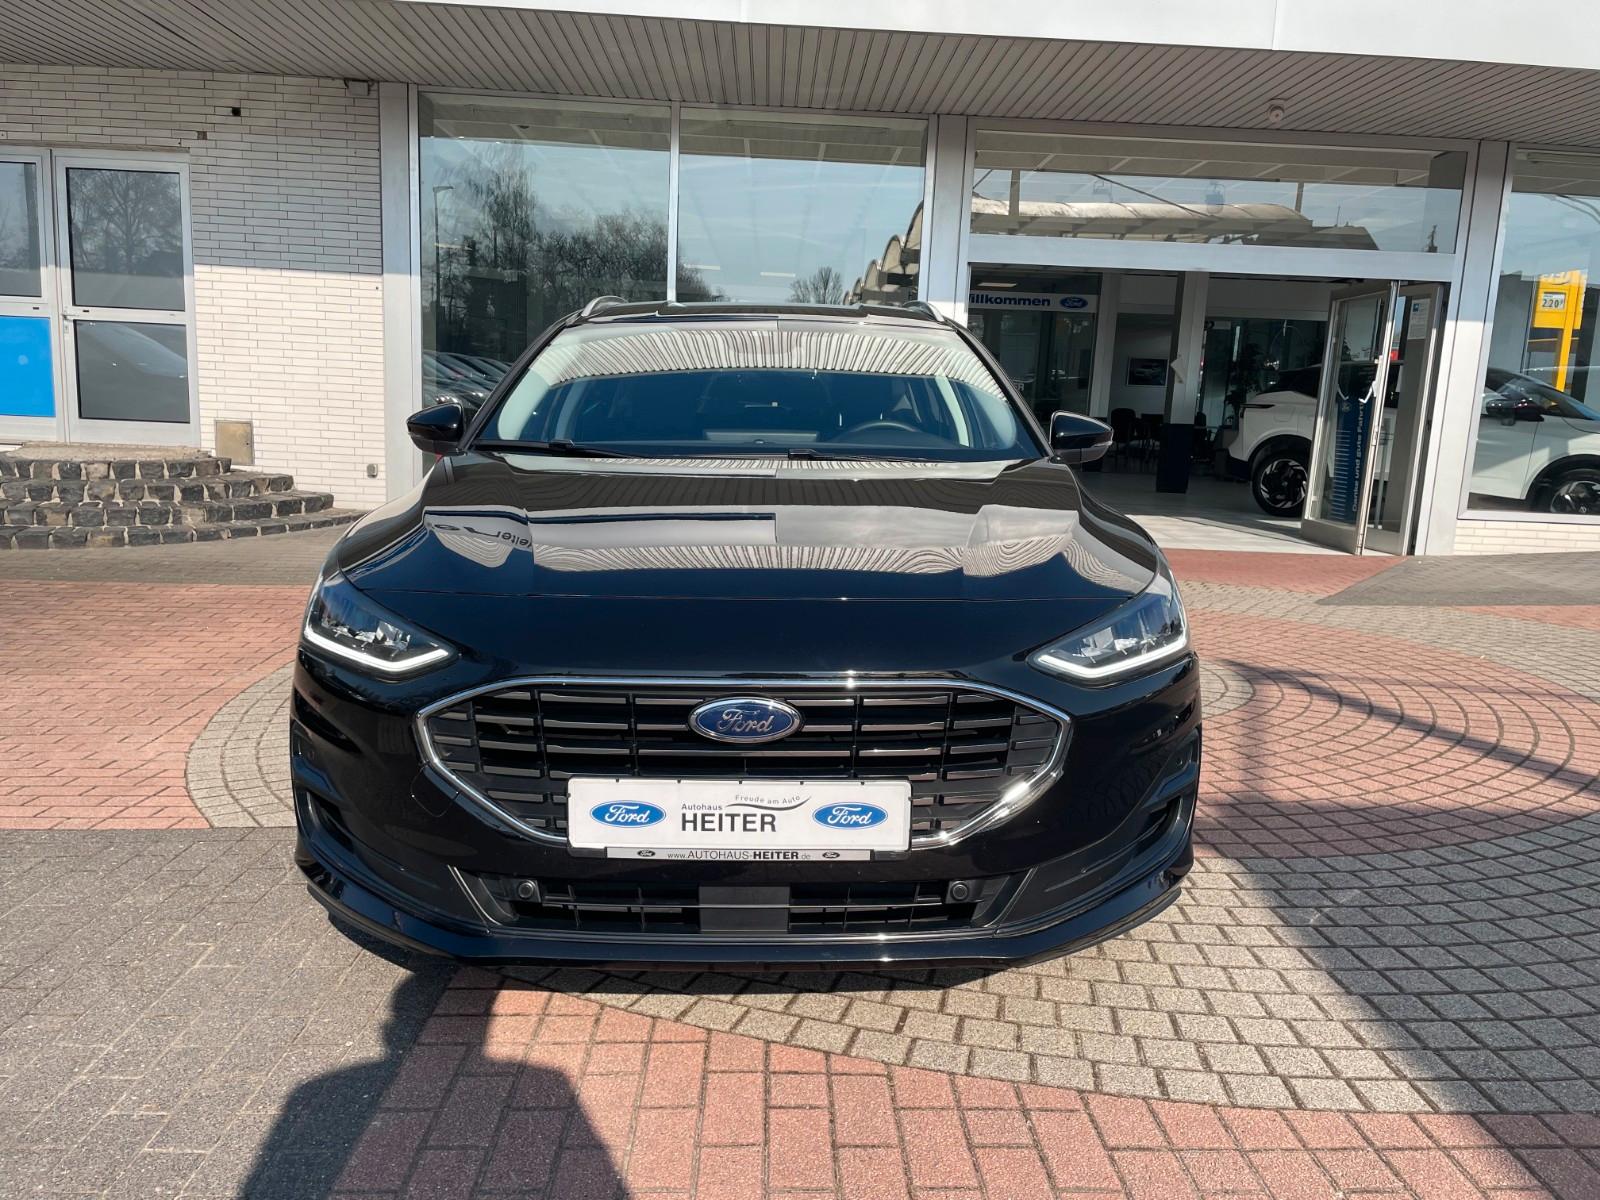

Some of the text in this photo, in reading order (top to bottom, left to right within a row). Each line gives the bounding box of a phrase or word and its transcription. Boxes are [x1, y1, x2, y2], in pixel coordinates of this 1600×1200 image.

[716, 708, 775, 733] Ford
[681, 803, 722, 811] Autohaus
[735, 794, 764, 803] Freude
[782, 795, 800, 804] Auto
[604, 804, 650, 823] Ford
[681, 812, 777, 832] HEITER
[827, 806, 873, 825] Ford
